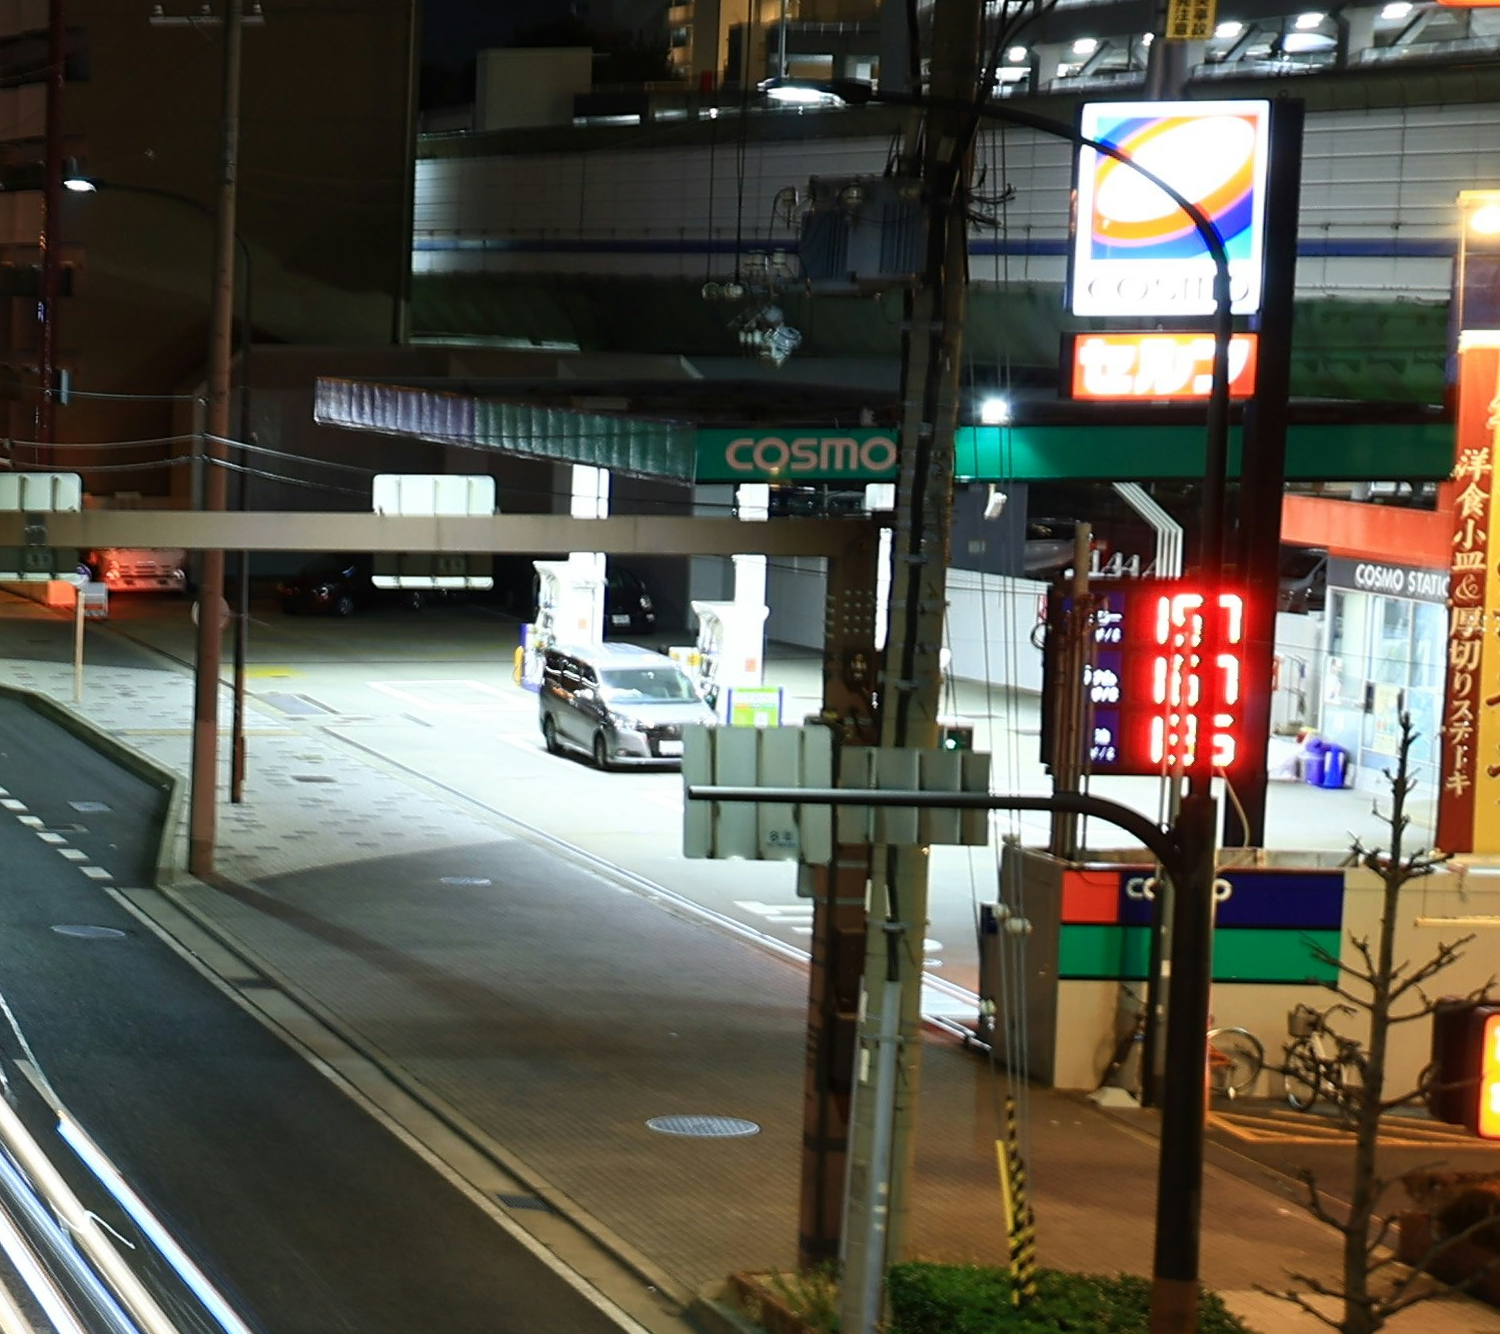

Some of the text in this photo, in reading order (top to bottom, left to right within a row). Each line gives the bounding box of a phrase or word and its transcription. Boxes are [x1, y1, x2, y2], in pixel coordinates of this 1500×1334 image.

[725, 436, 897, 471] COSMO
[1355, 562, 1404, 592] COSMO
[1156, 593, 1243, 648] 157
[1126, 876, 1234, 902] COO
